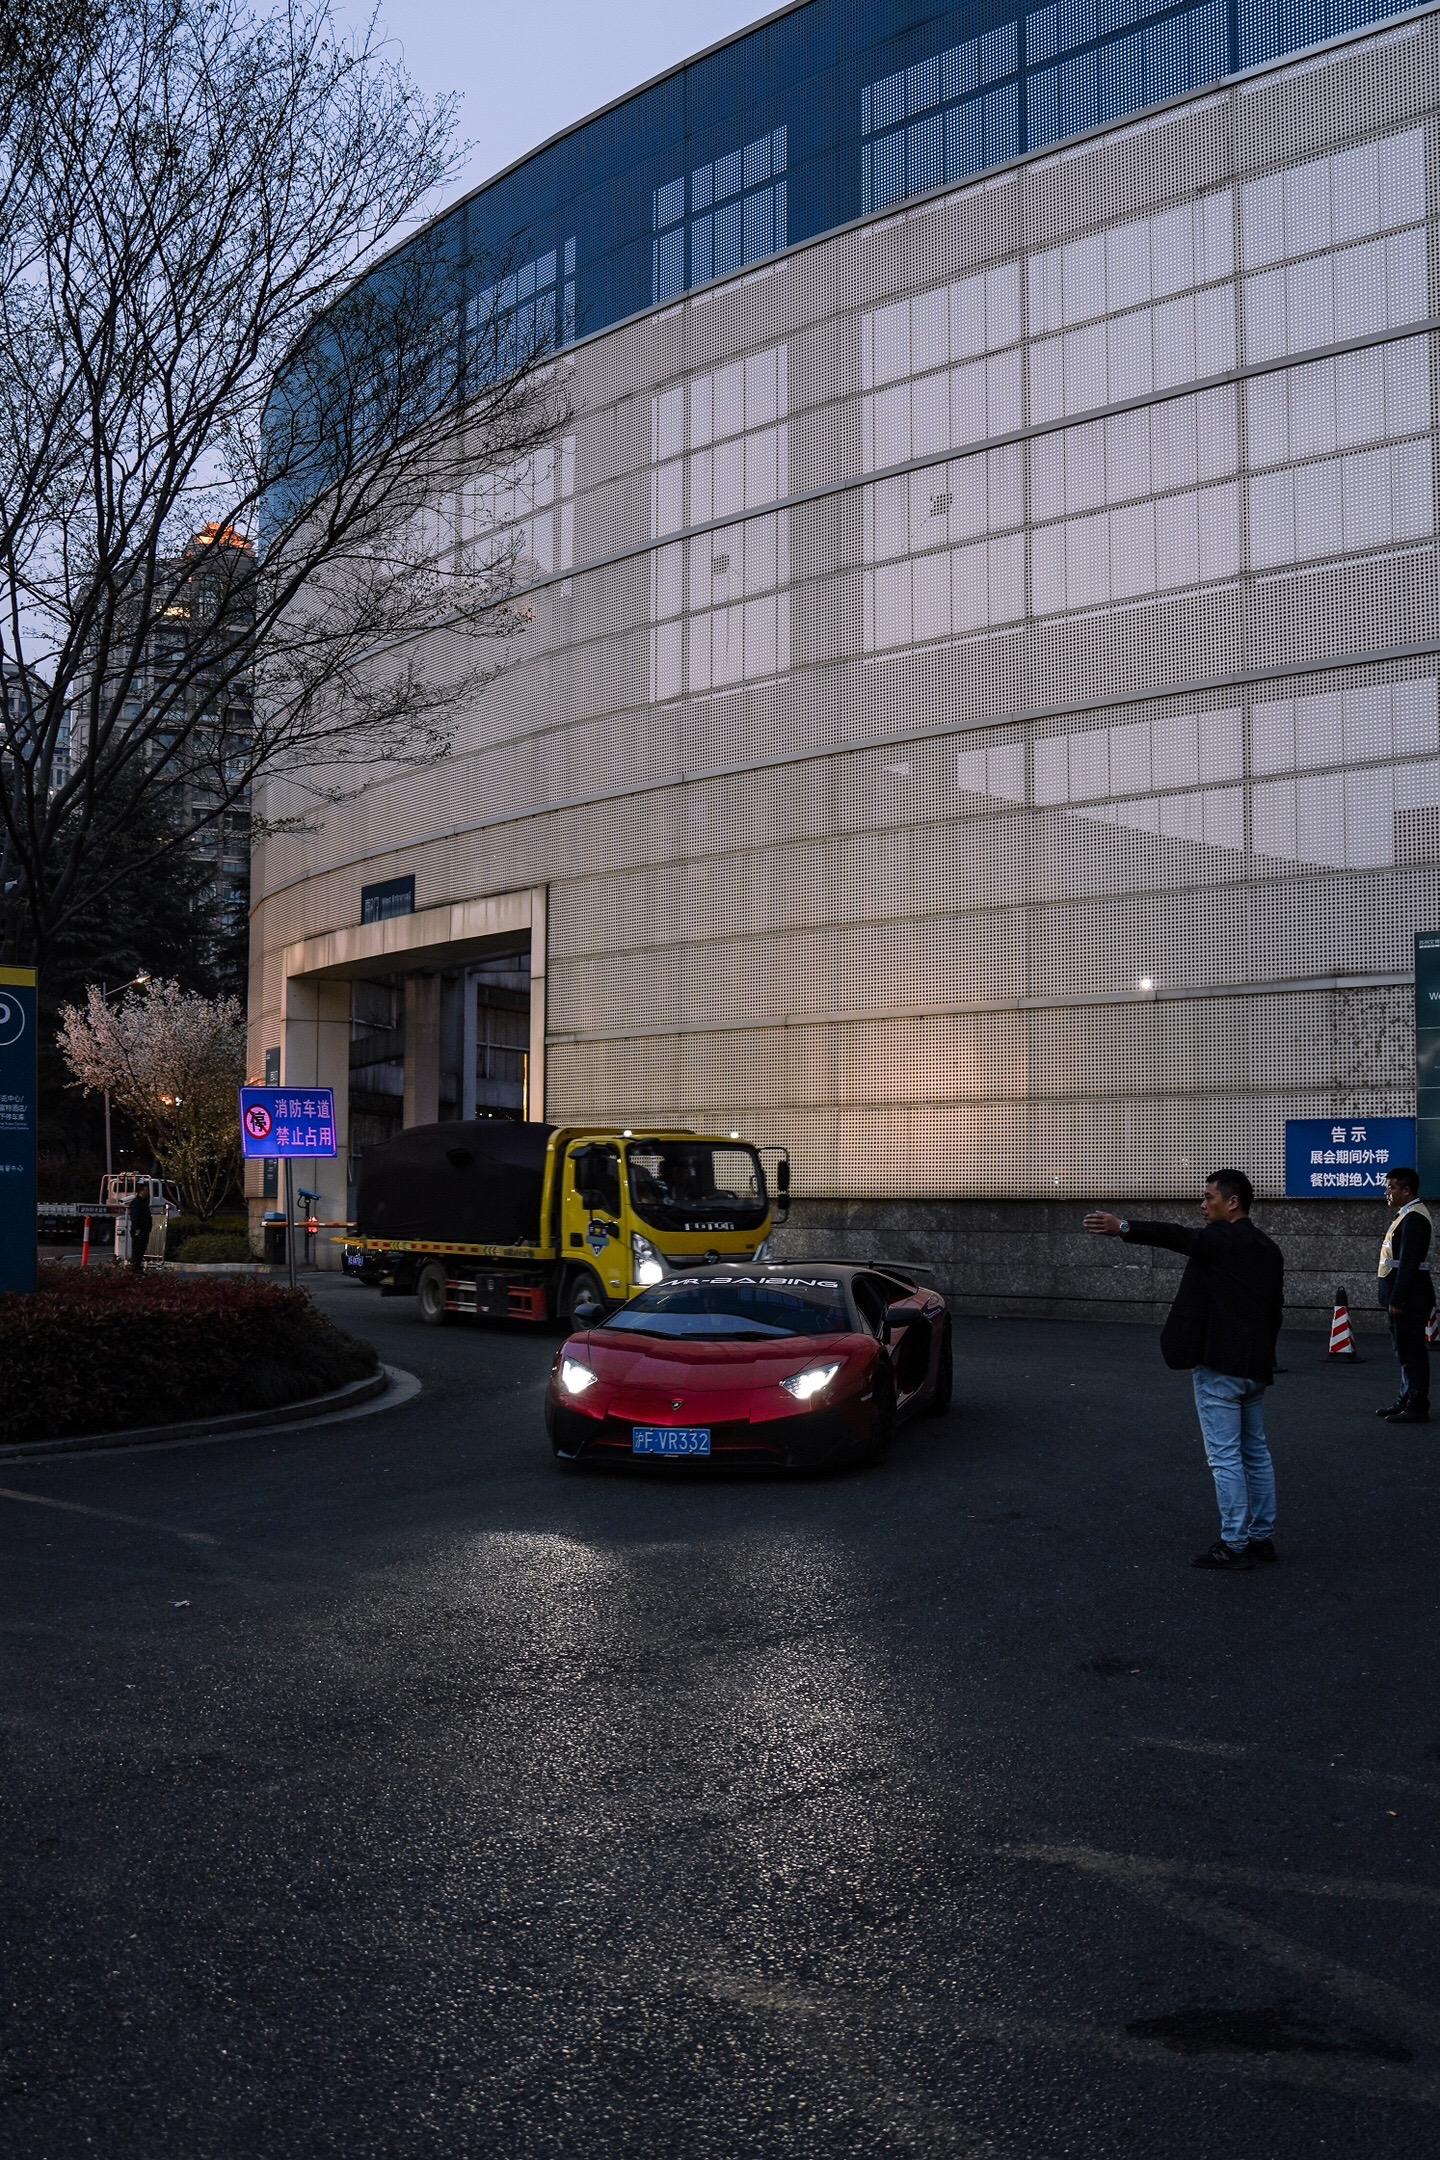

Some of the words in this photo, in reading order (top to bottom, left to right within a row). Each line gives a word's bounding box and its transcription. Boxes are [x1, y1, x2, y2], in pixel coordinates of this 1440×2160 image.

[274, 1098, 331, 1119] 消防车道
[275, 1126, 333, 1147] 禁止占用
[1330, 1126, 1367, 1144] 告示
[1309, 1149, 1390, 1165] 展会期间外带
[1309, 1172, 1389, 1188] 餐饮谢绝入场
